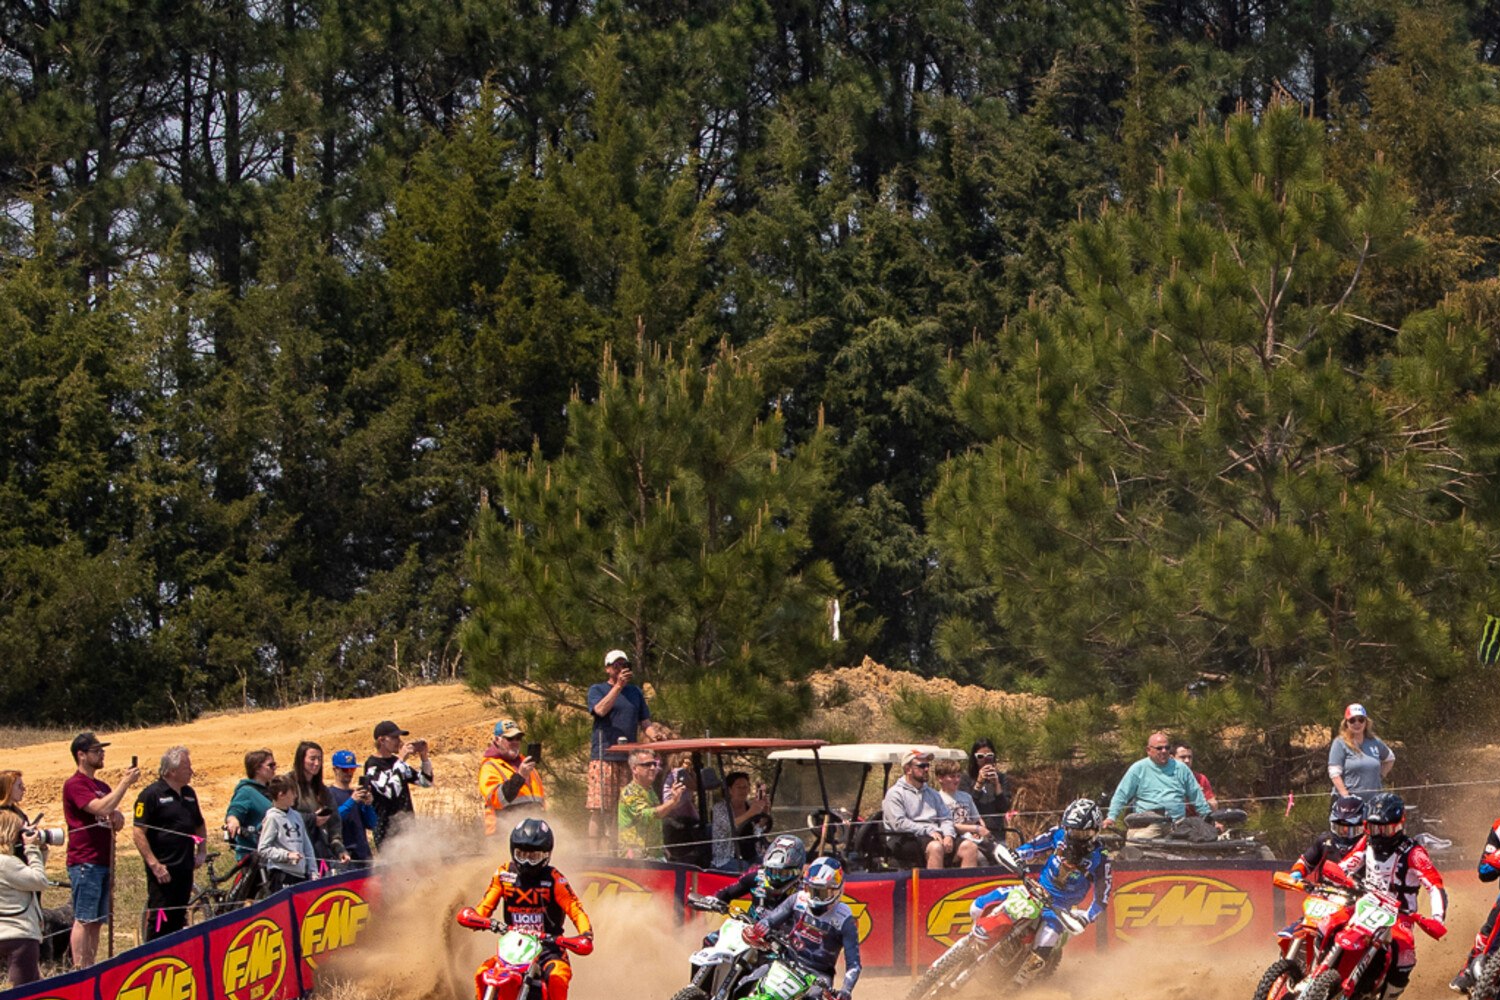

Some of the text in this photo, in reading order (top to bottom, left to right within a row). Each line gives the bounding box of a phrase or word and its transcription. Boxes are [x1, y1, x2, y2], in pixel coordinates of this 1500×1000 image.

[504, 886, 552, 905] FXR
[1113, 884, 1248, 928] FMF
[1356, 903, 1389, 928] 19
[302, 898, 369, 957] FMF
[225, 928, 283, 995] FMF
